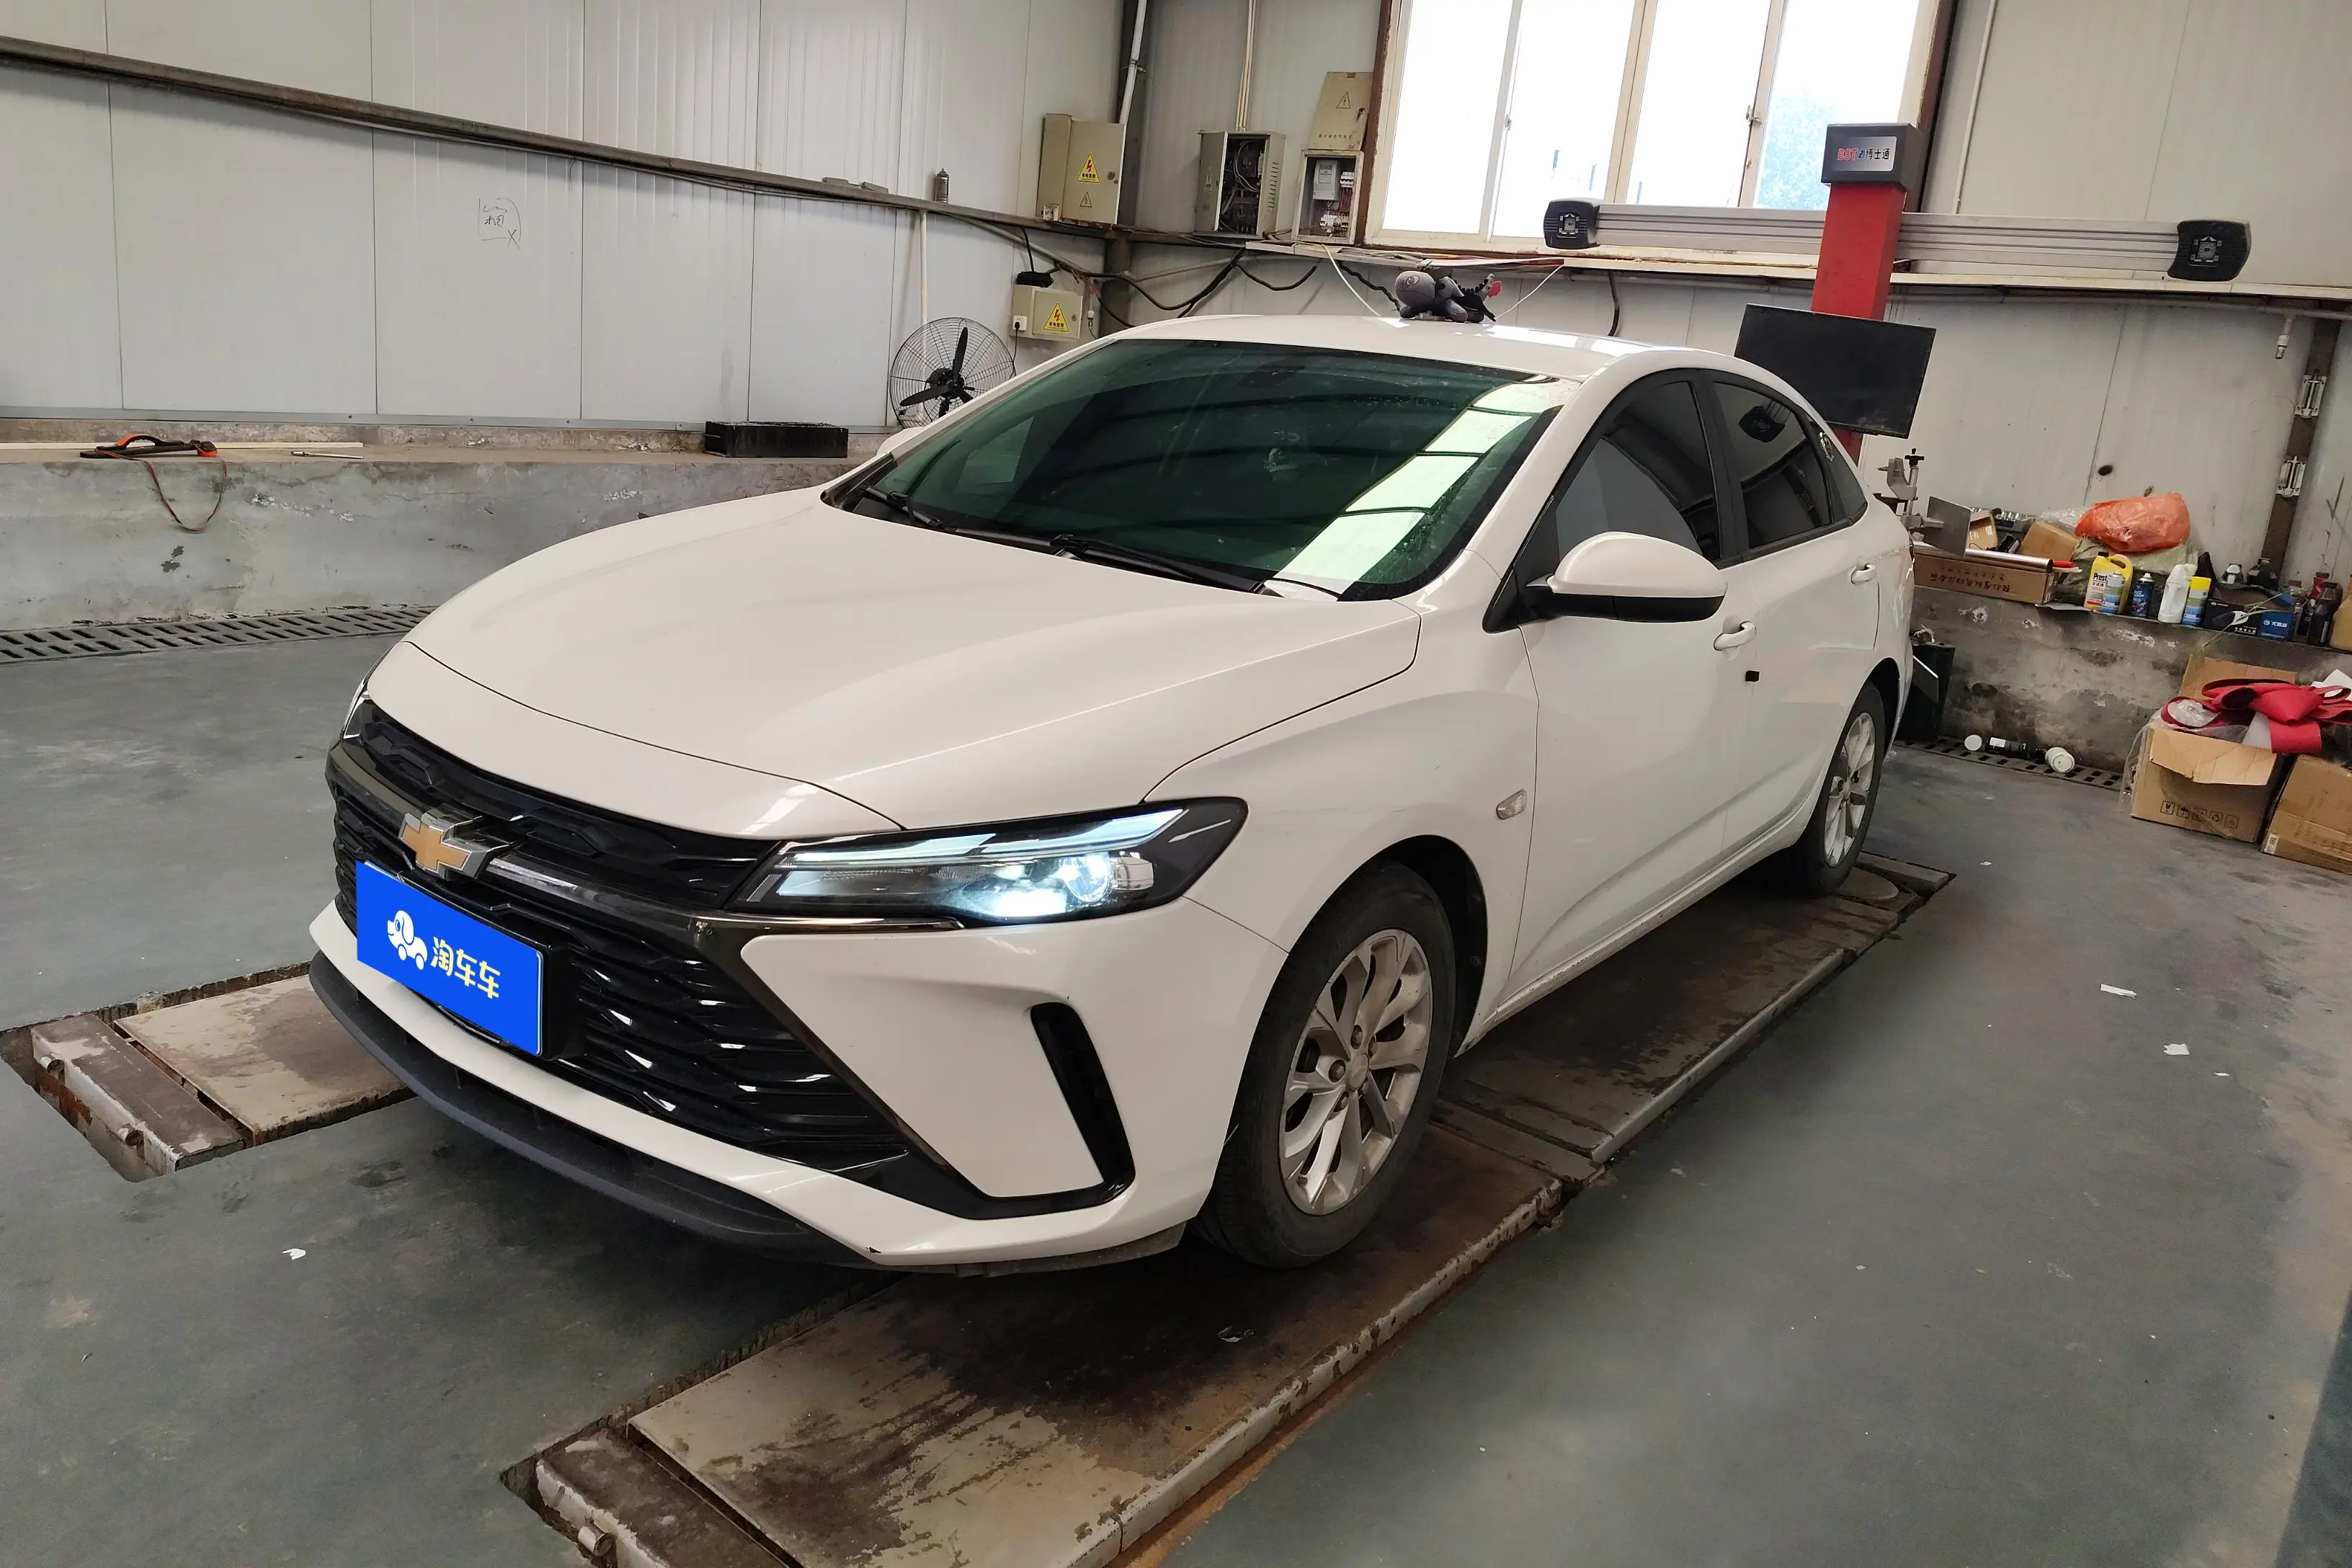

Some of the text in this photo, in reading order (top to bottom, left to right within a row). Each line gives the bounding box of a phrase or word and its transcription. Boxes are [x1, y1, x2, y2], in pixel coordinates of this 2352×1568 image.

[1838, 148, 1890, 161] BST 博士通
